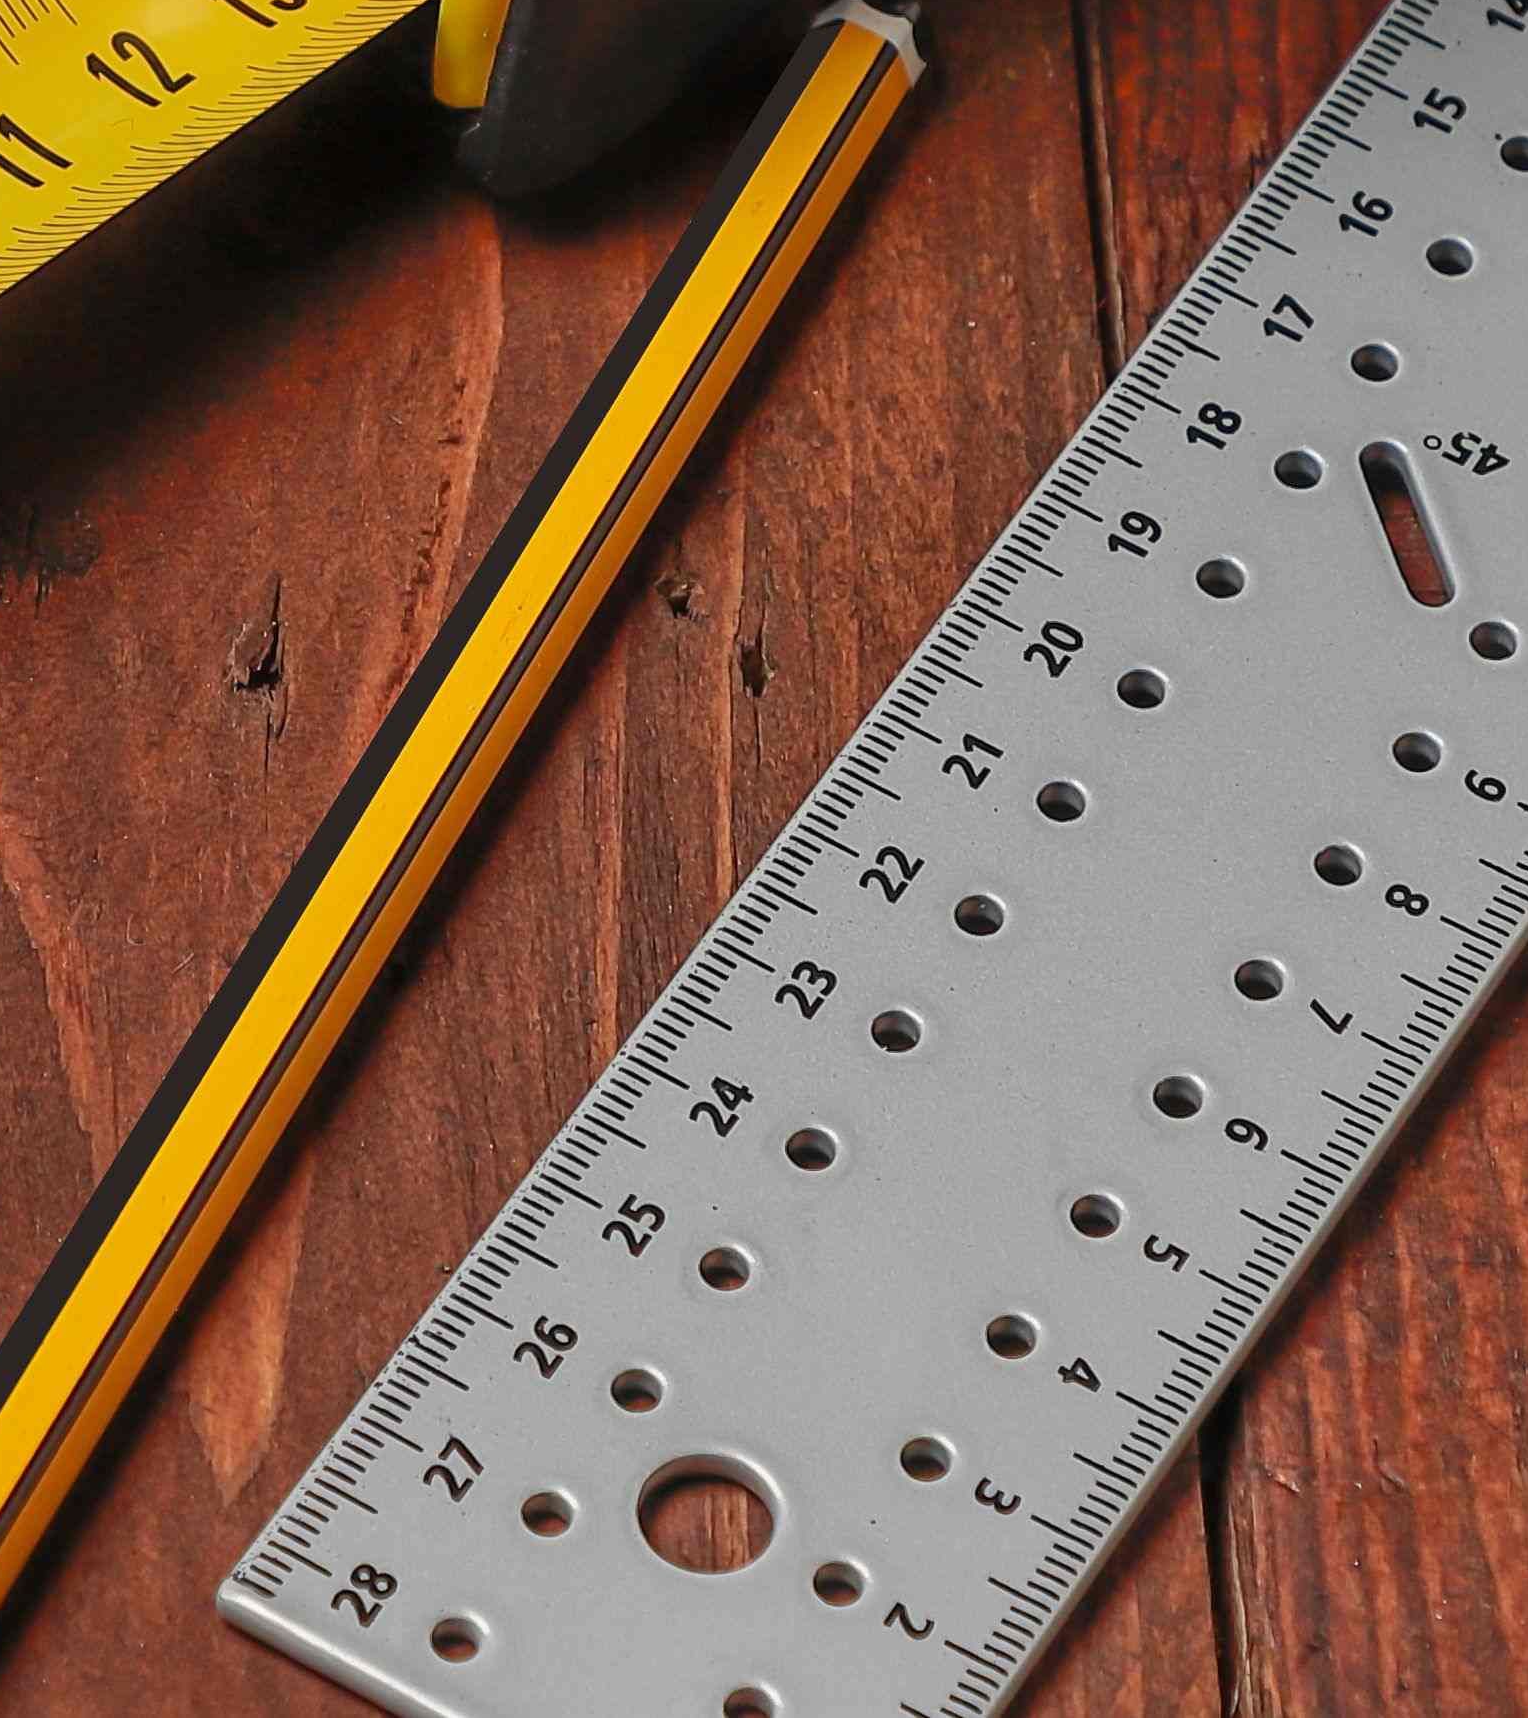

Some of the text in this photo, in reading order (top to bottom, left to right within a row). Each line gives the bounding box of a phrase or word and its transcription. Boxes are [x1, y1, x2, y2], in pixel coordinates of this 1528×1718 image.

[86, 31, 196, 108] 12
[1413, 87, 1467, 134] 15
[1338, 190, 1393, 237] 16
[1263, 293, 1315, 343] 17
[1186, 402, 1242, 450] 18
[1423, 432, 1510, 476] 45°
[1107, 511, 1162, 558] 19
[1023, 621, 1084, 678] 20
[941, 733, 1004, 790] 21
[1464, 769, 1507, 802] 9
[859, 845, 925, 904] 22
[1384, 884, 1430, 917] 8
[774, 960, 837, 1020] 23
[1309, 998, 1353, 1035] 7
[689, 1076, 755, 1138] 24
[1224, 1118, 1269, 1152] 6
[601, 1193, 666, 1258] 25
[1143, 1234, 1190, 1273] 5
[513, 1315, 578, 1380] 26
[1057, 1357, 1101, 1393] 4
[422, 1435, 484, 1502] 27
[974, 1477, 1022, 1515] 3
[330, 1563, 398, 1628] 28
[883, 1601, 935, 1640] 2
